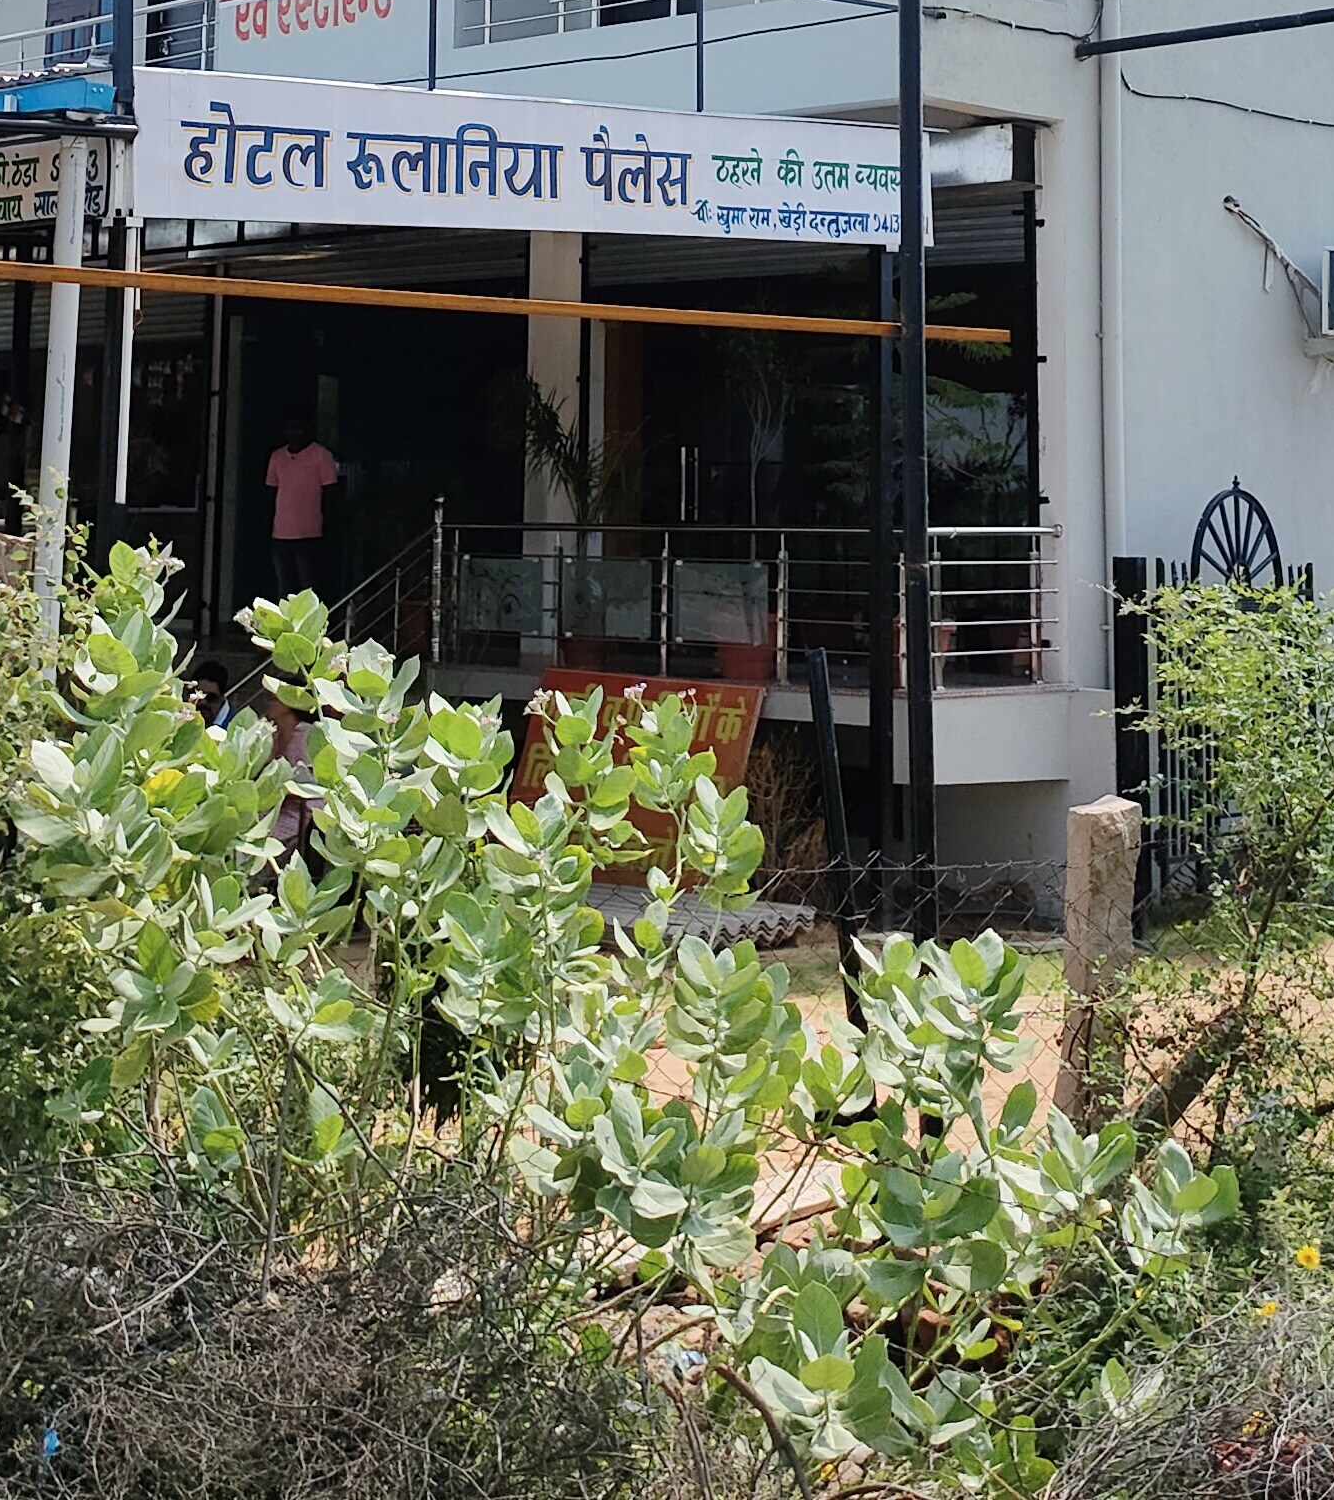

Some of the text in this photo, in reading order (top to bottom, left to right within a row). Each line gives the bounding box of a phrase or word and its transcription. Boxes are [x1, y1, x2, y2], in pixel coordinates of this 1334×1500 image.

[181, 101, 692, 206] होटल रूलानिया पैलेस
[777, 148, 805, 188] की
